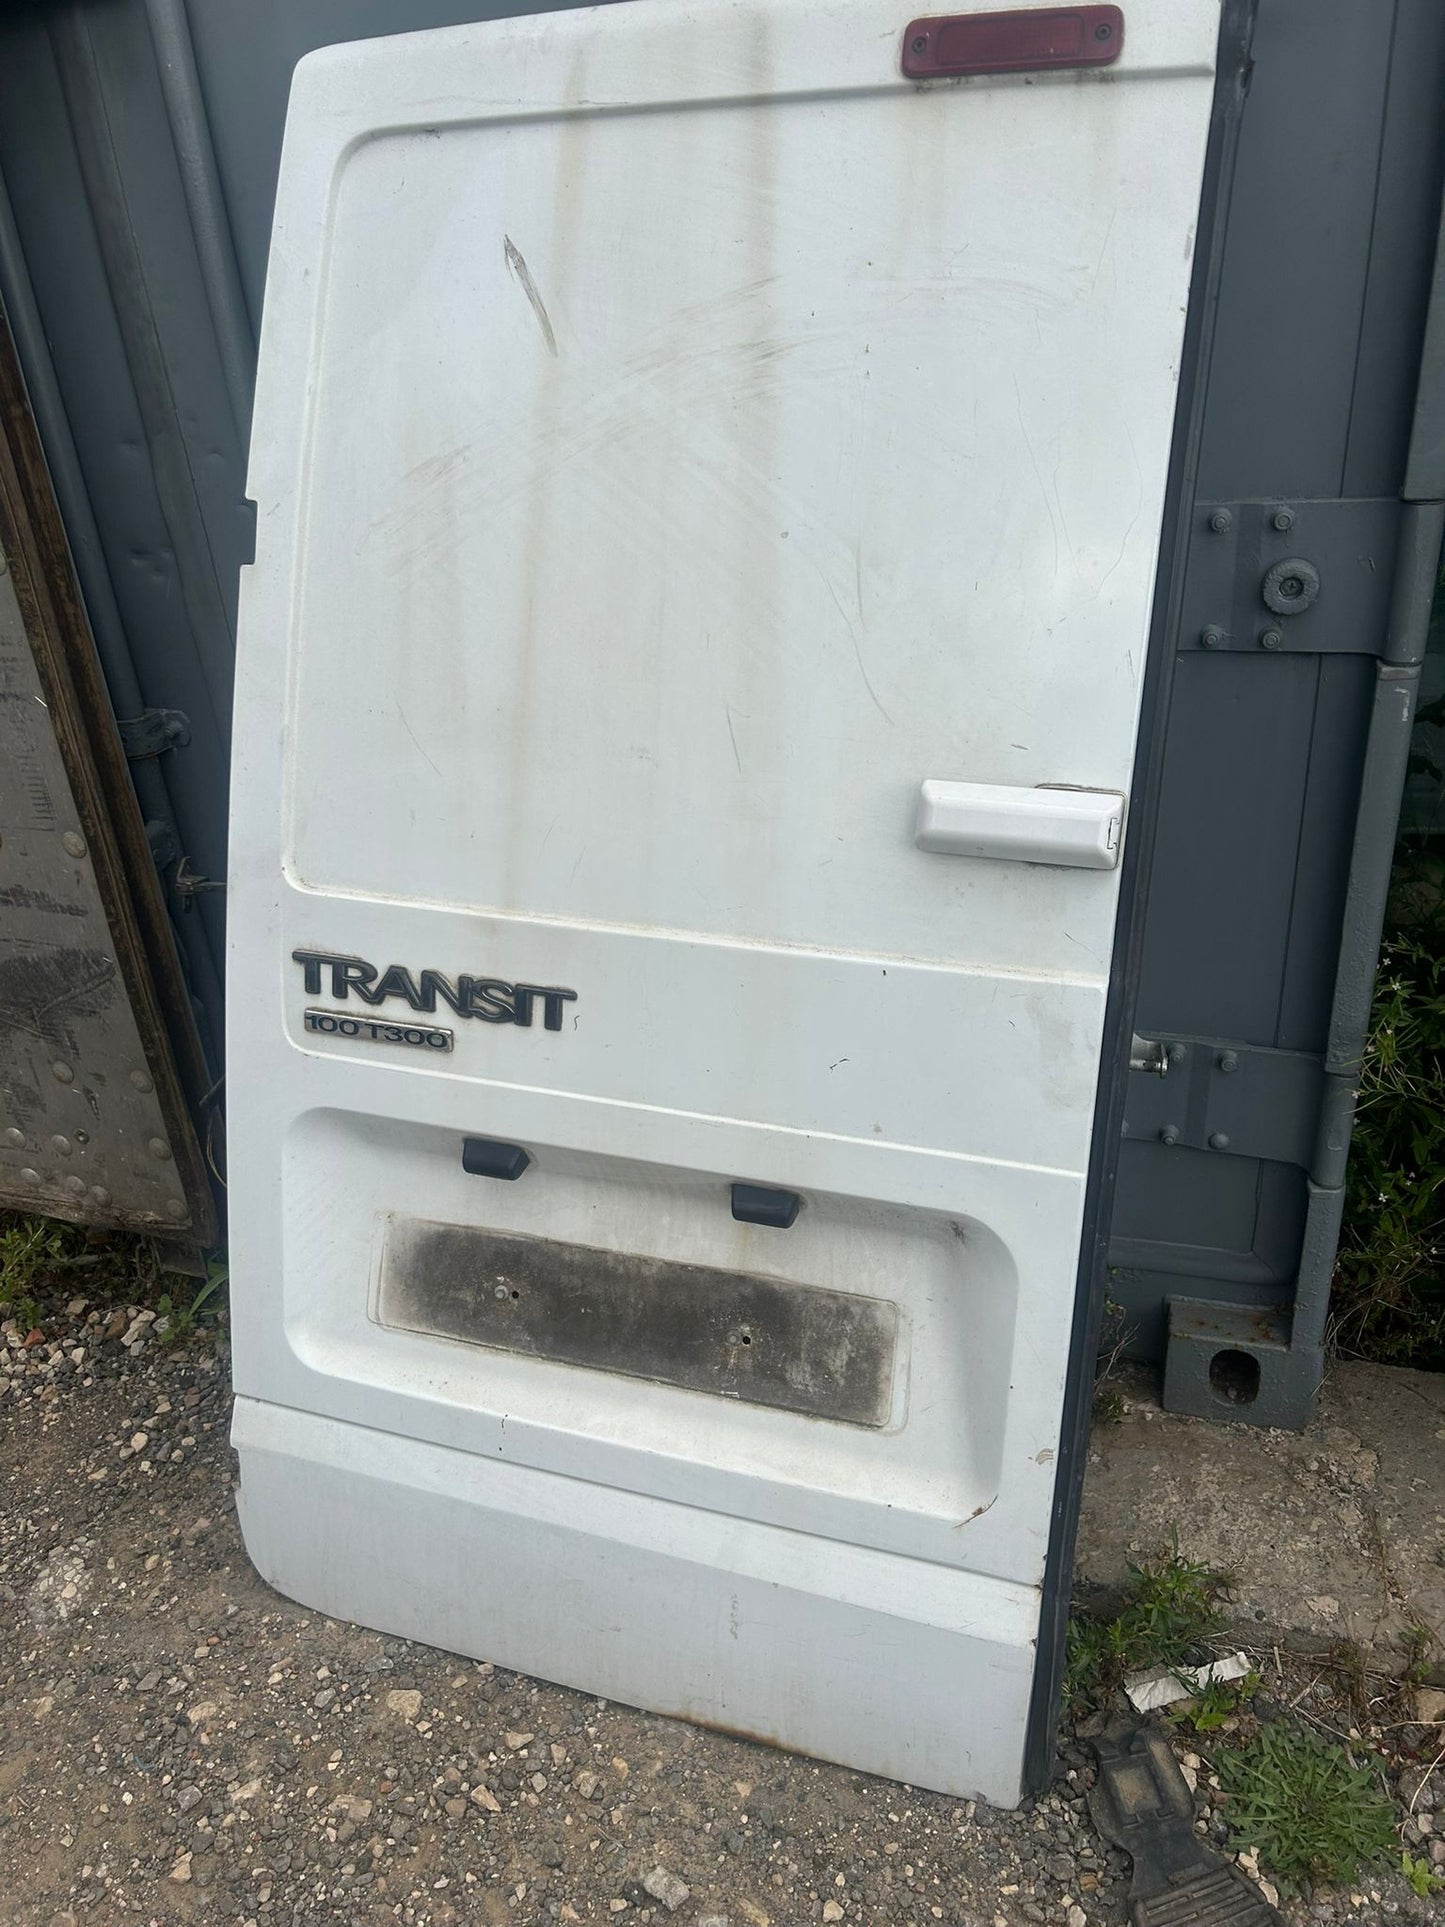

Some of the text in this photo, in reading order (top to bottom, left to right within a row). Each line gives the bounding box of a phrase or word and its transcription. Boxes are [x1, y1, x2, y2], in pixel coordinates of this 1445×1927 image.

[291, 949, 578, 1032] TRANSIT
[305, 1014, 449, 1049] 100 T300
